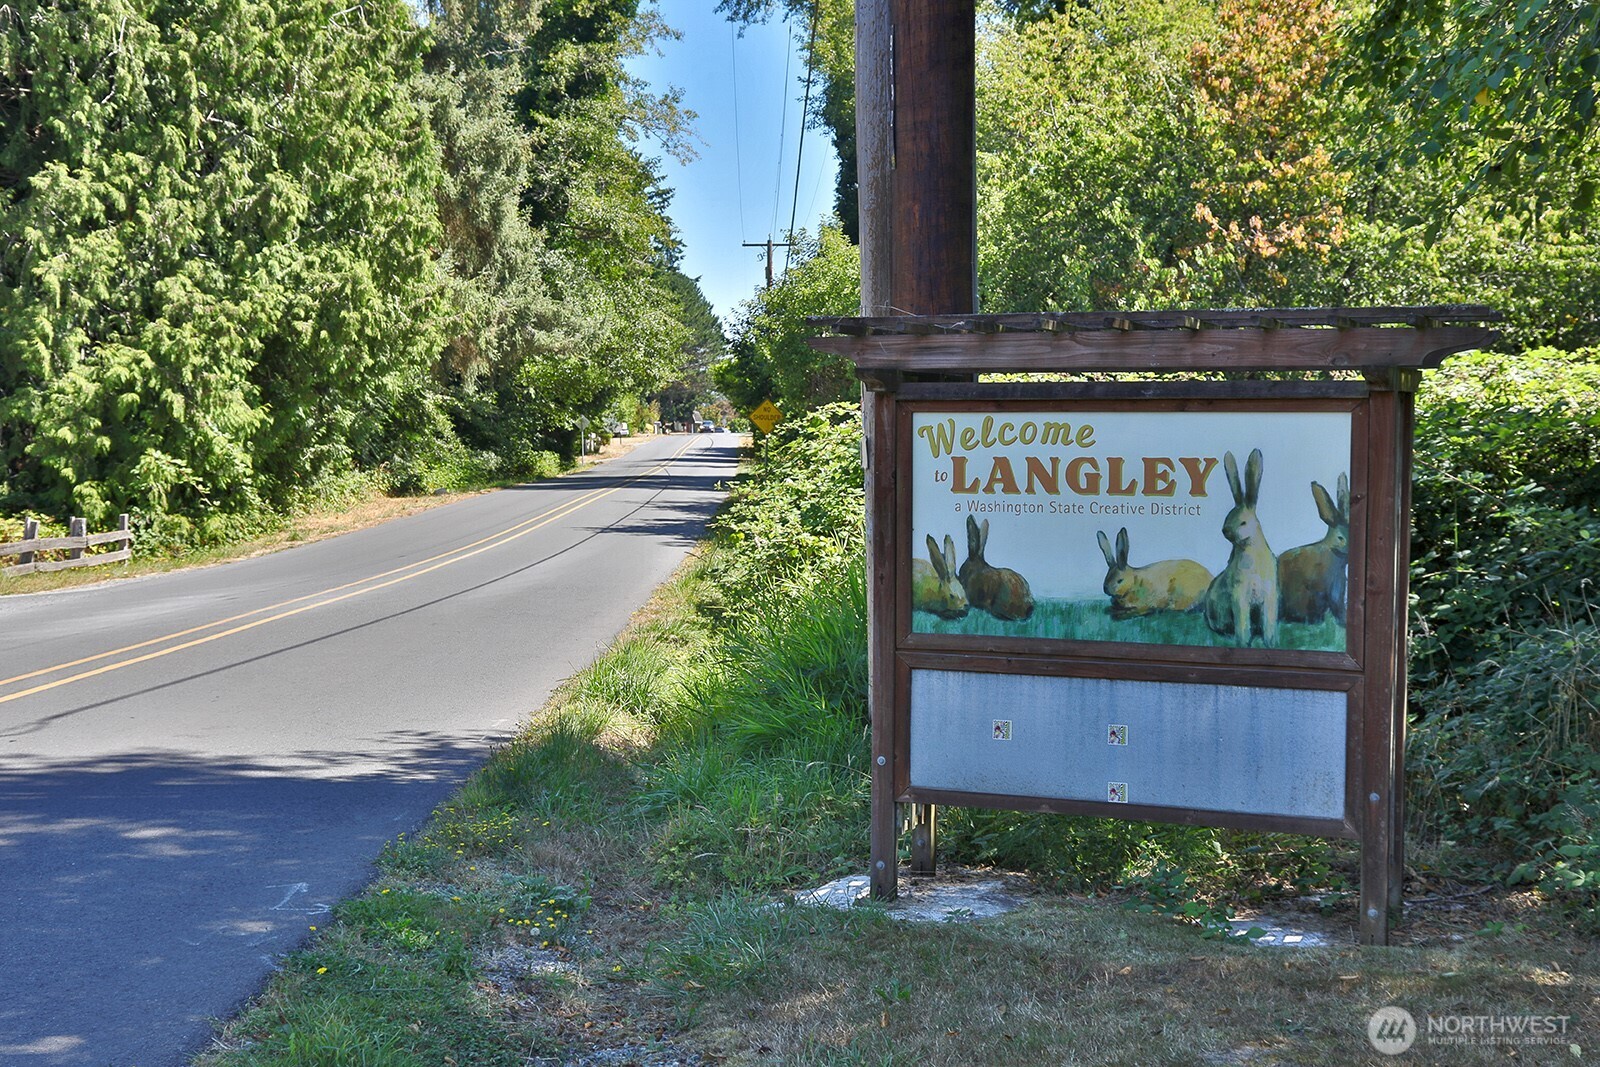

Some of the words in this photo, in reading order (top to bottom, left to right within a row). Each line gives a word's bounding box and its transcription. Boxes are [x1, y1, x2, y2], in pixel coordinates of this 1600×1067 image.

[917, 415, 1097, 458] Welcome
[934, 468, 949, 483] to
[950, 456, 1219, 497] LANGLEY
[954, 503, 962, 513] a
[967, 500, 1044, 516] Washington
[1049, 501, 1085, 515] State
[1089, 501, 1145, 515] Creative
[1150, 502, 1201, 516] District
